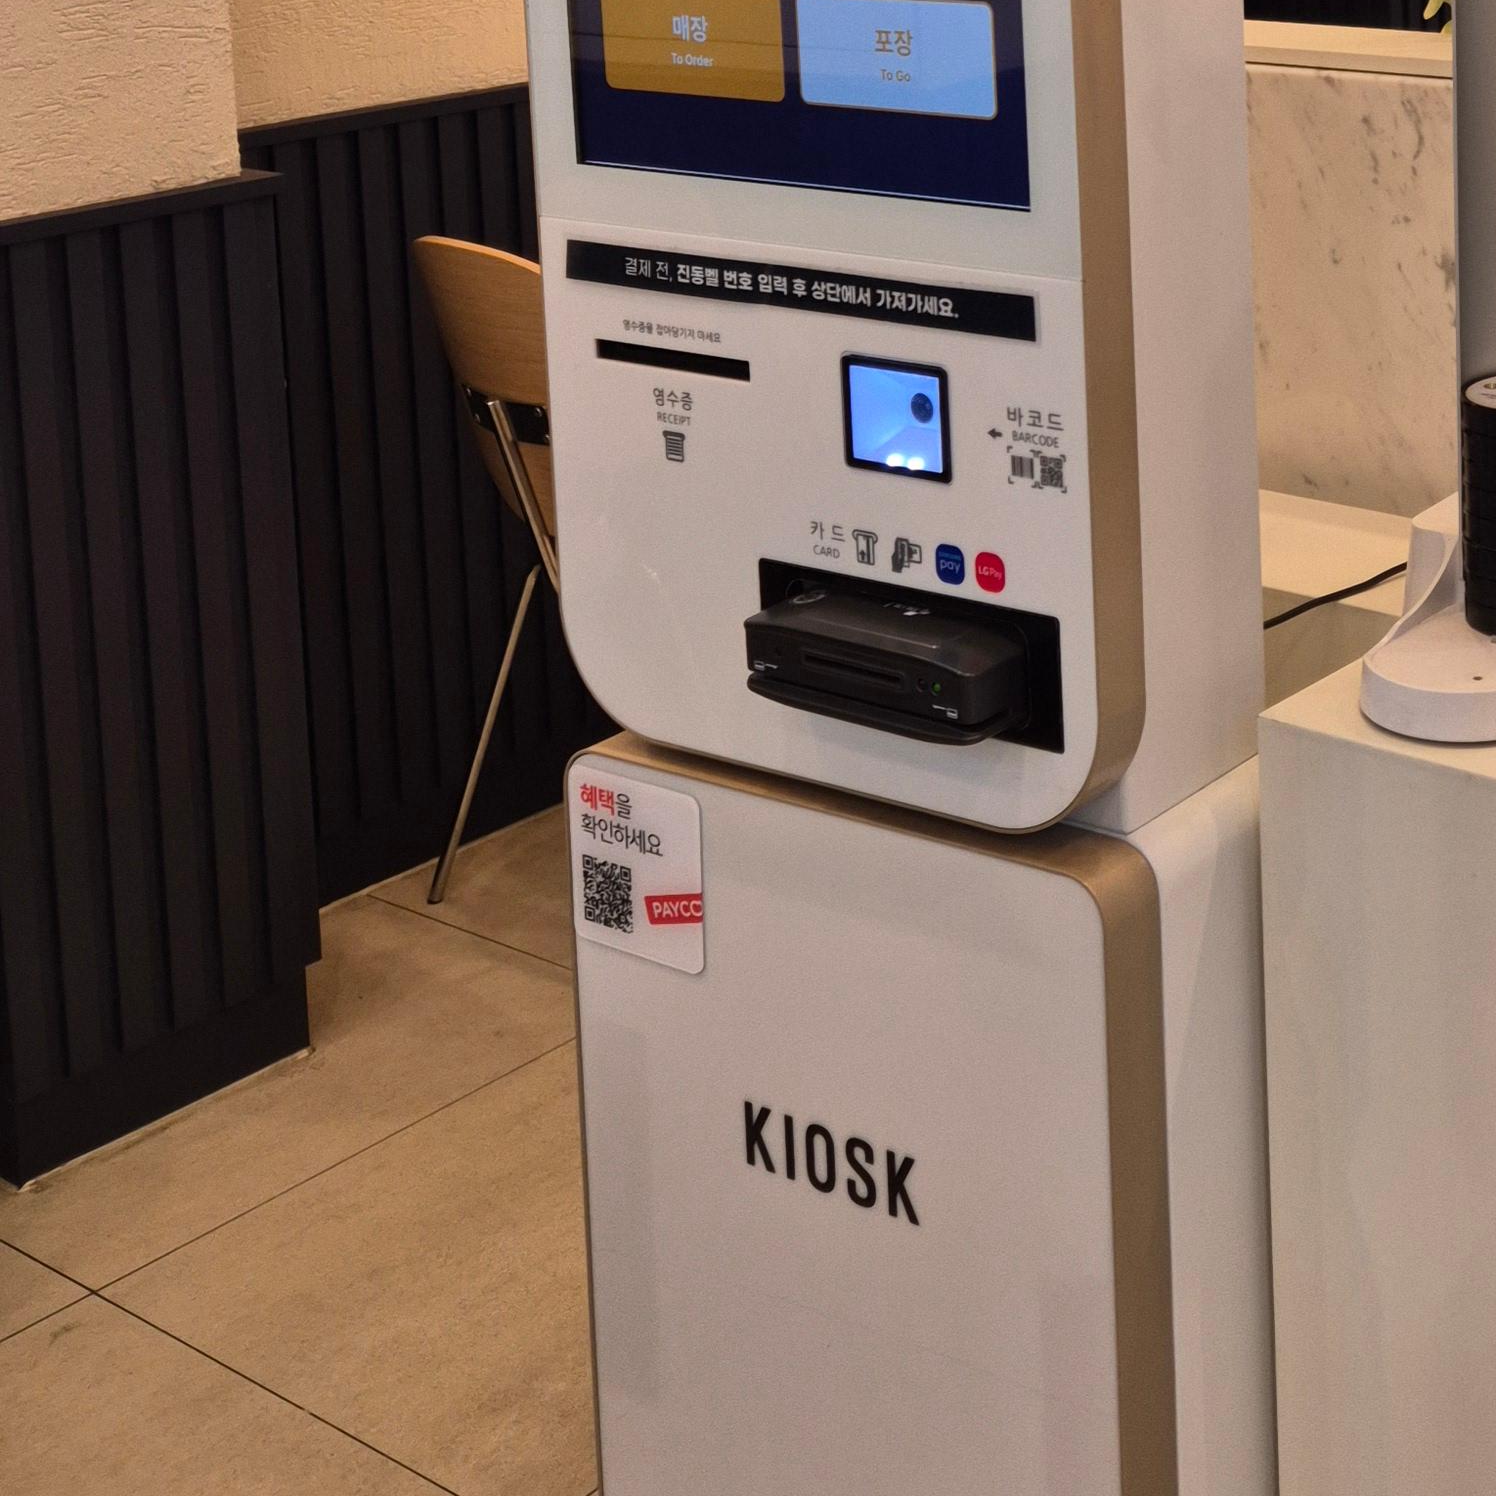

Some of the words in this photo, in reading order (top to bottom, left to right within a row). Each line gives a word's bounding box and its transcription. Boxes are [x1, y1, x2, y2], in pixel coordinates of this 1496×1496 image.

[672, 14, 708, 44] 매장
[874, 28, 912, 58] 포장
[671, 52, 684, 66] To
[685, 53, 714, 68] Order
[880, 69, 893, 82] To
[895, 70, 911, 84] Go
[624, 256, 652, 279] 결제
[656, 259, 673, 283] 전,
[676, 261, 720, 288] 진동벨
[723, 267, 754, 292] 번호
[757, 271, 789, 296] 입력
[792, 277, 807, 299] 후
[811, 279, 872, 308] 상단에서
[875, 288, 959, 319] 가져가세요.
[653, 387, 693, 411] 영수증
[656, 411, 691, 426] RECEIPT
[1007, 407, 1064, 431] 바코드
[1012, 430, 1059, 448] BARCODE
[810, 521, 845, 543] 카드
[813, 544, 840, 560] CARD
[940, 559, 961, 575] pay
[579, 783, 633, 819] 혜택을
[580, 813, 664, 857] 확인하세요
[744, 1100, 920, 1227] KIOSK
